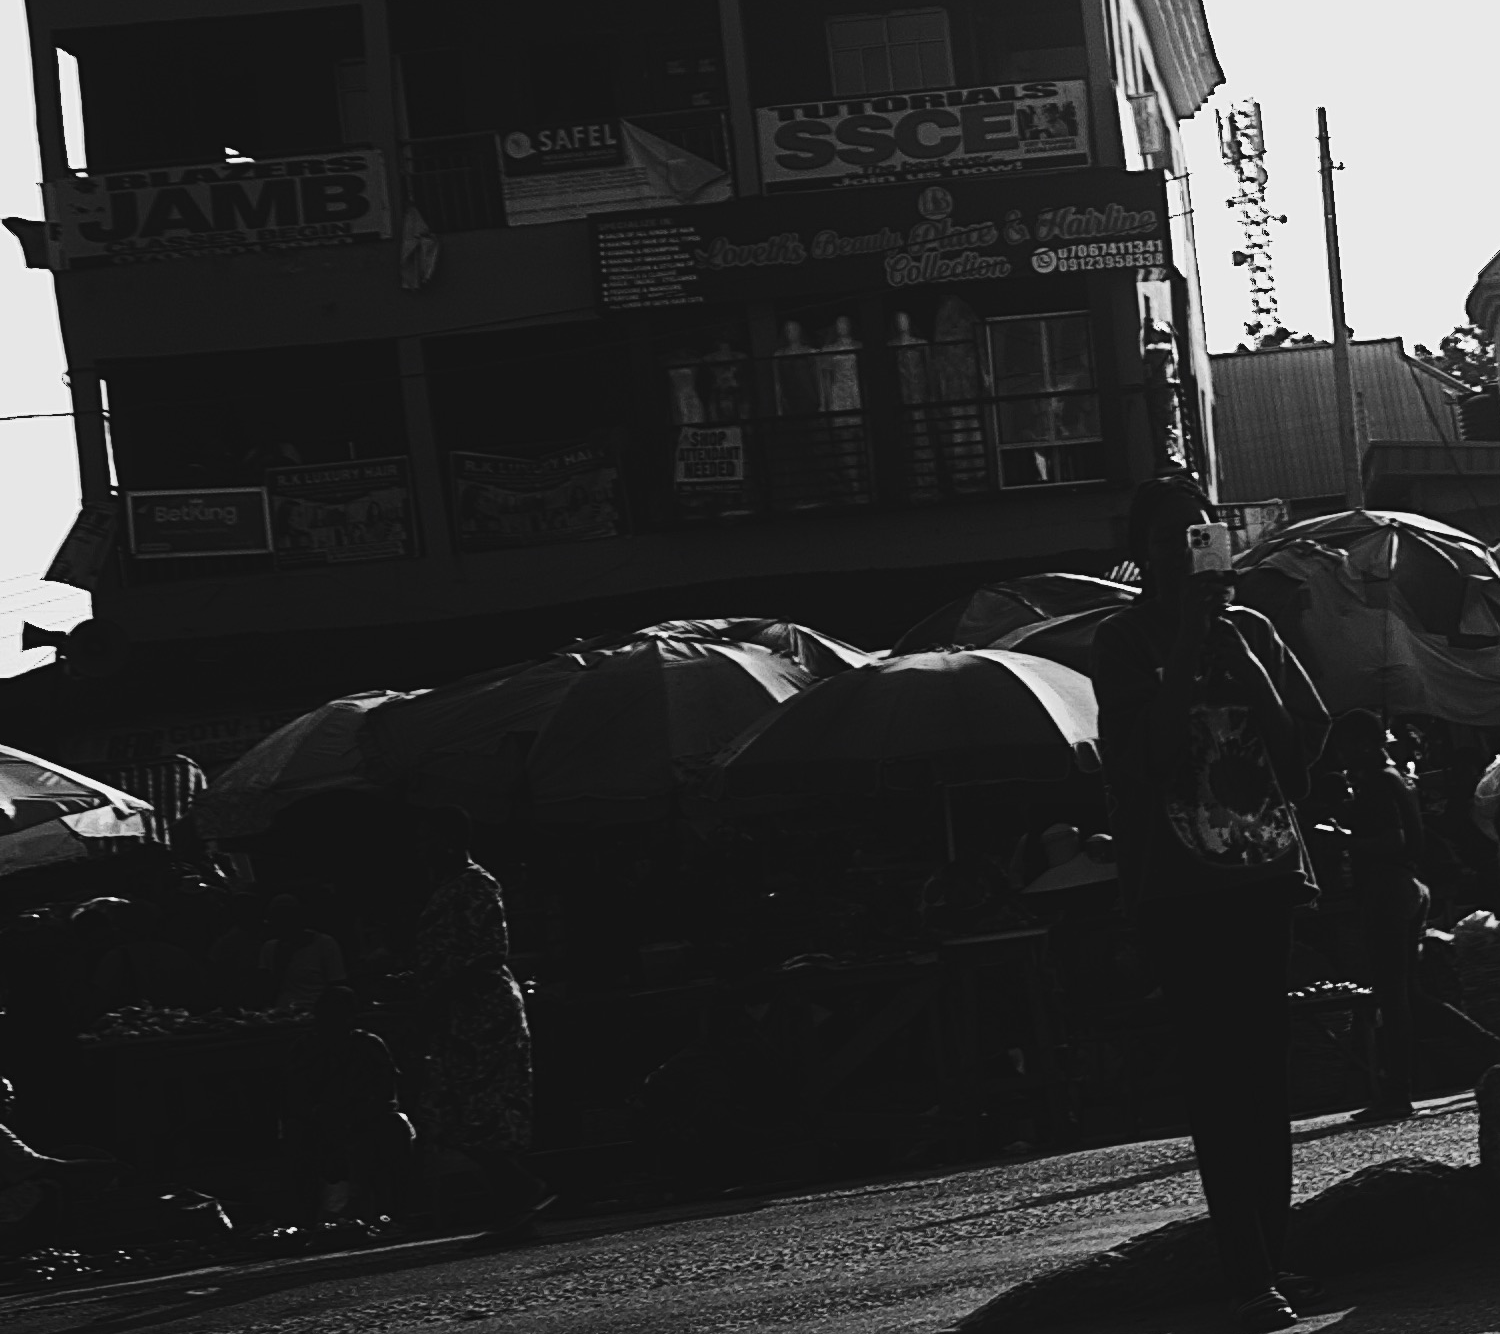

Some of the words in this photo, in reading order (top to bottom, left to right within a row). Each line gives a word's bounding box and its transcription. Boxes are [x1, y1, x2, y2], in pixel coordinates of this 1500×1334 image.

[770, 82, 1058, 121] TUTORIALS
[538, 123, 617, 151] SAFEL
[774, 102, 1020, 171] SSCE
[105, 155, 369, 192] BLAZERS
[832, 174, 897, 188] Join
[906, 170, 943, 181] us
[77, 174, 371, 244] JAMB
[255, 222, 354, 243] BEGIN
[885, 250, 1011, 287] Collection
[690, 431, 727, 447] SHOP
[684, 461, 736, 478] NEEDED
[169, 718, 241, 744] GOTV
